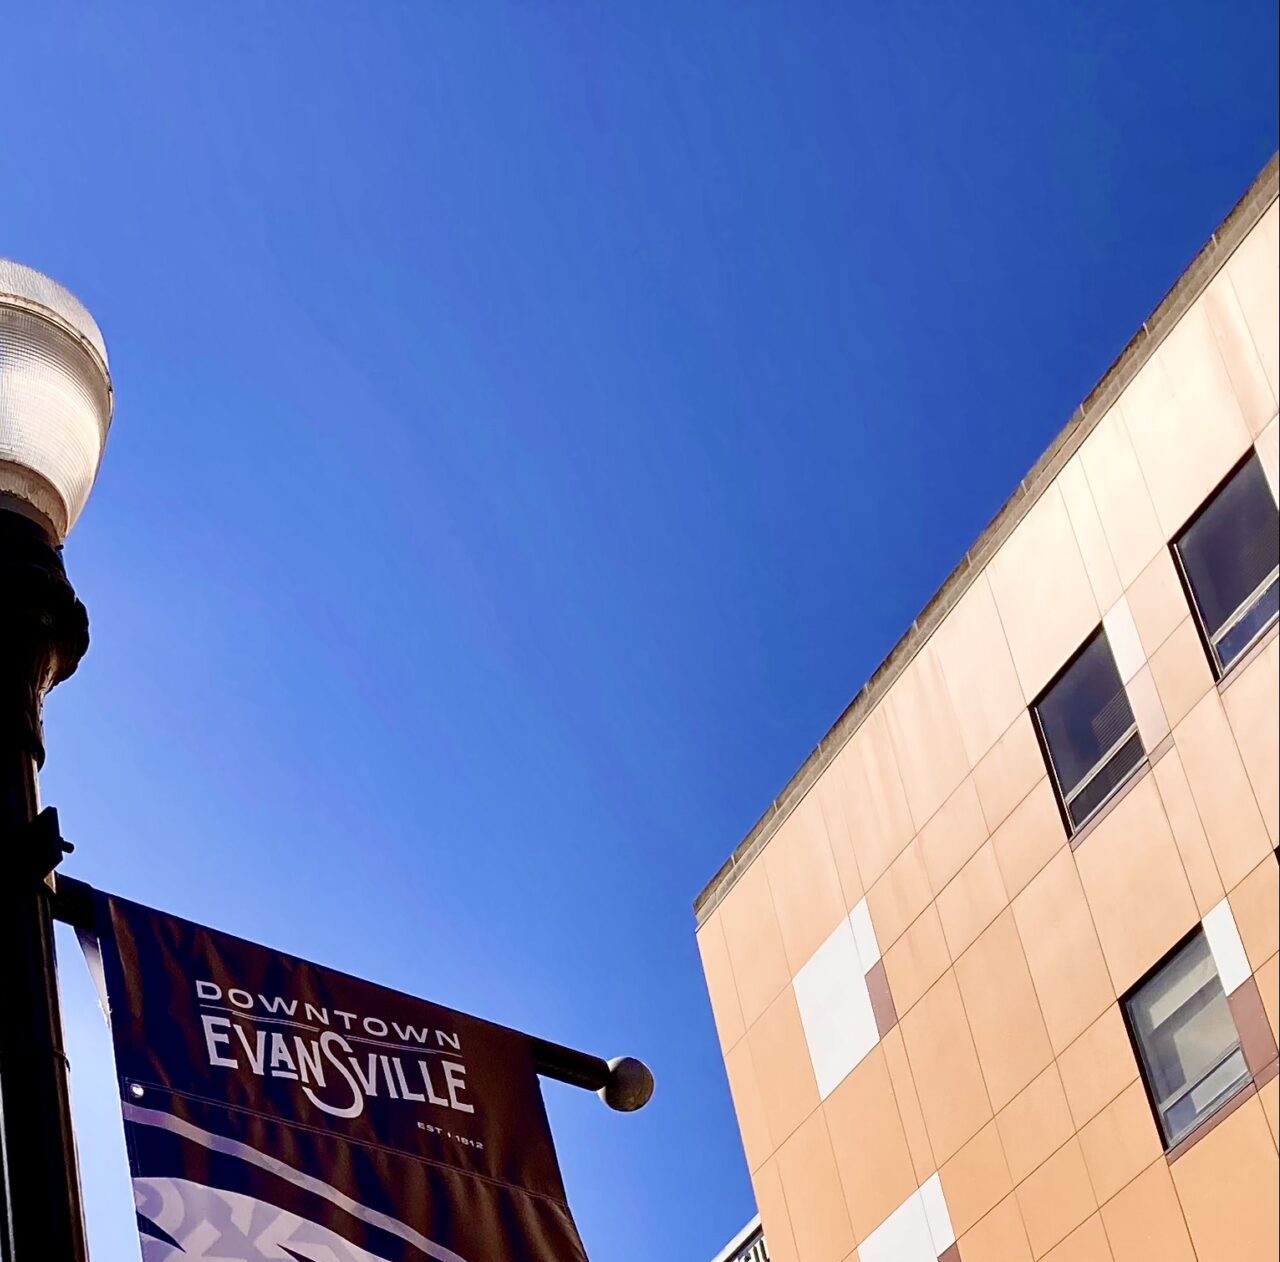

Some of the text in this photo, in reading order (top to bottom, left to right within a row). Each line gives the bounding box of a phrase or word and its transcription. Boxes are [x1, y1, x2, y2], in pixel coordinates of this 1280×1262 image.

[195, 979, 461, 1050] DOWNTOWN
[201, 1014, 474, 1119] EVANSVILLE
[417, 1121, 484, 1149] EST 1812
